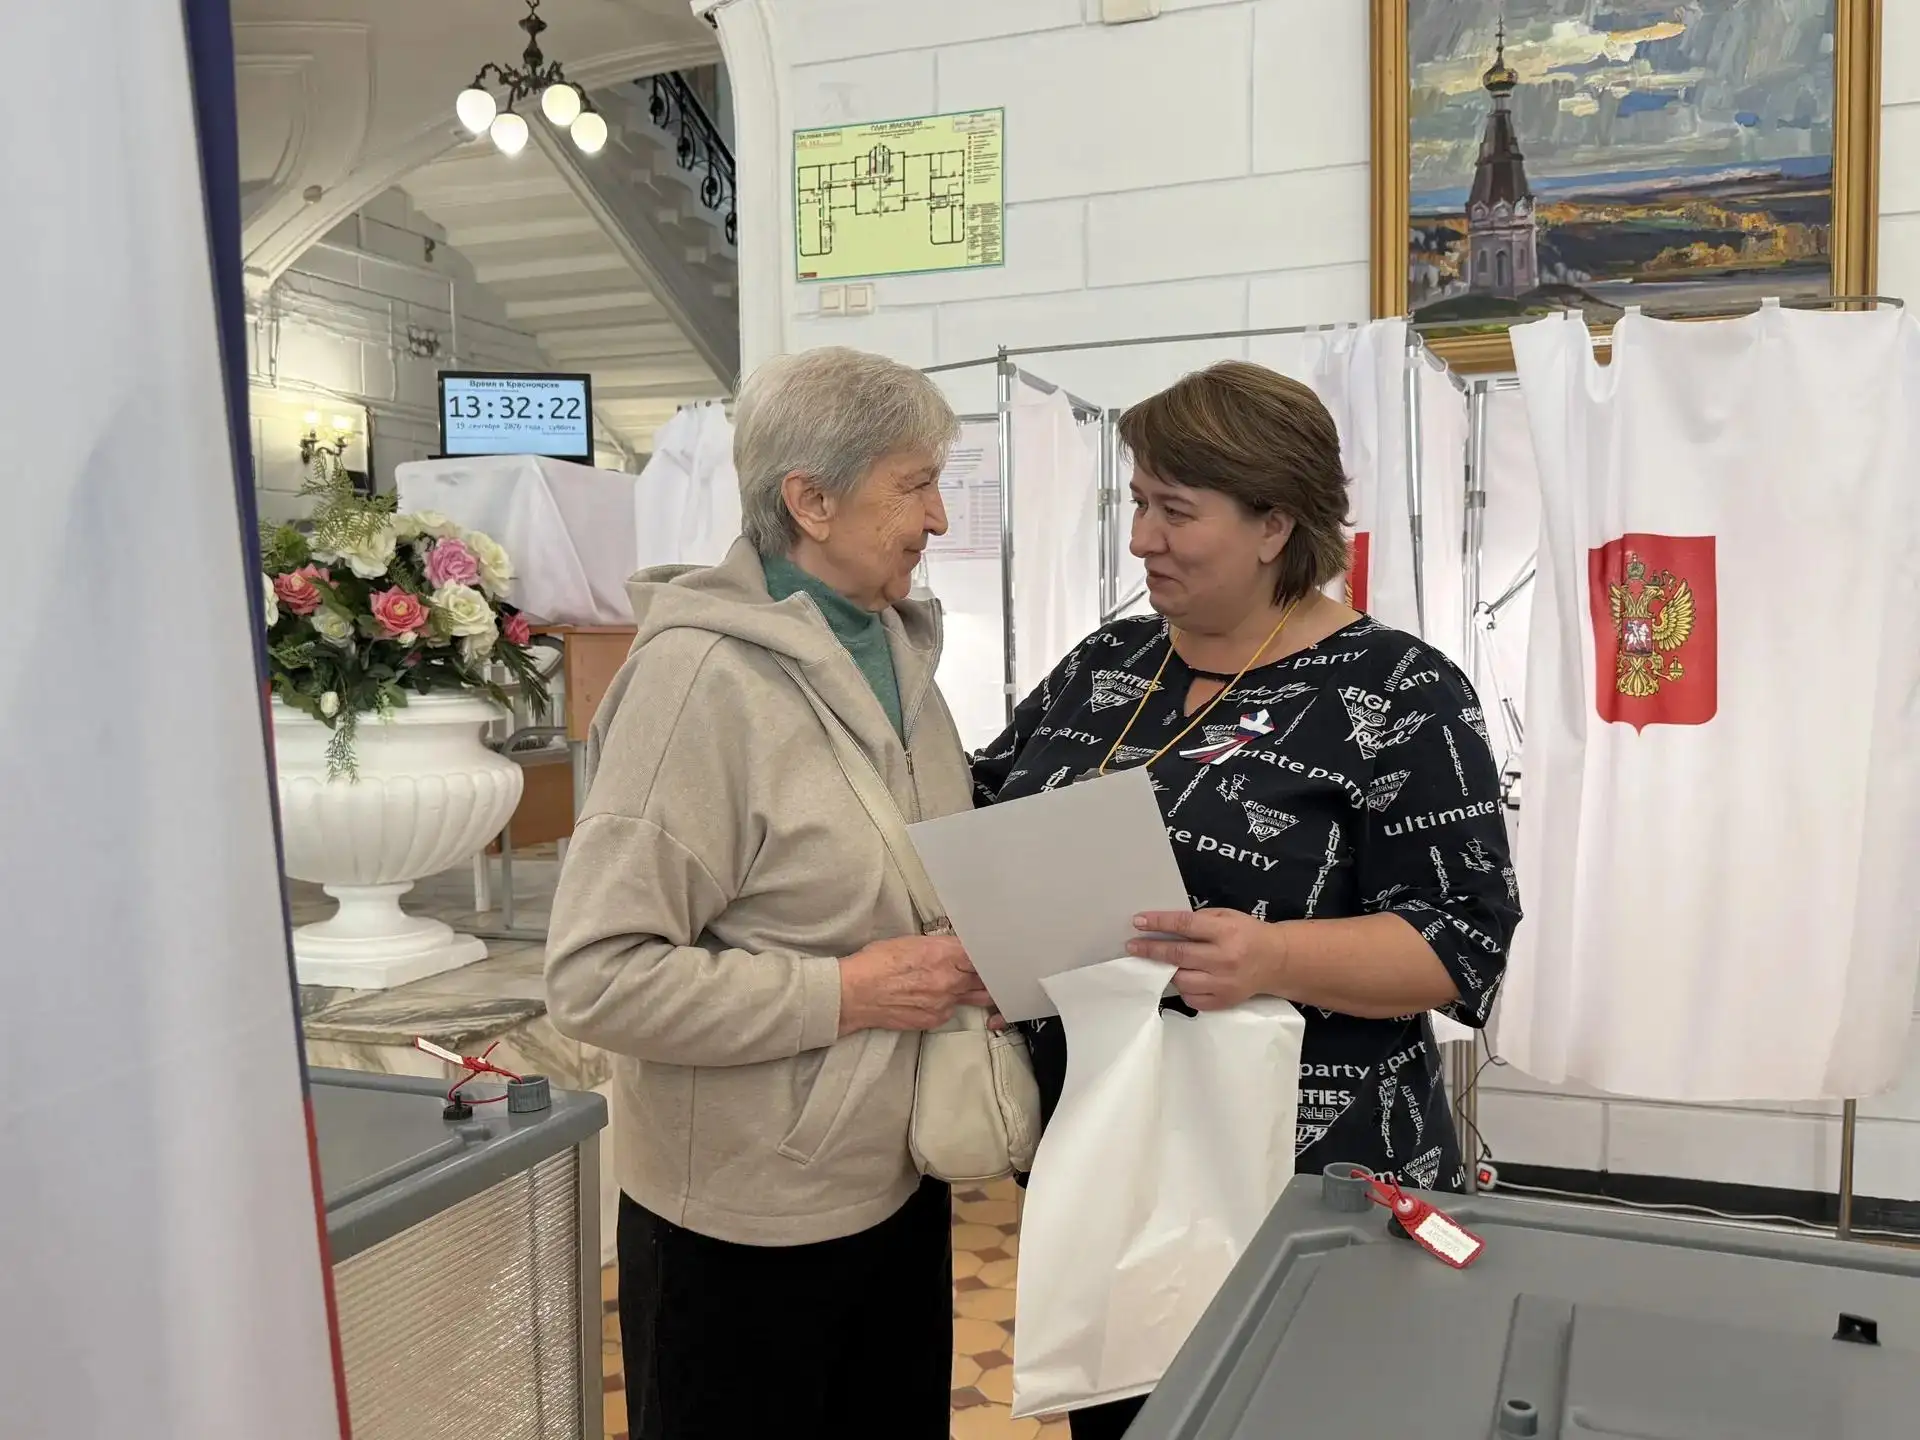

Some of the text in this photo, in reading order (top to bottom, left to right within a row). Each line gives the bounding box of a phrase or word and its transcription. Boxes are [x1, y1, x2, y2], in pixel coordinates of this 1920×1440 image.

[469, 380, 497, 389] Время
[506, 381, 560, 389] Красноярске
[449, 396, 582, 419] 13:32:22
[1293, 649, 1368, 670] party
[1384, 659, 1410, 692] ultimate
[1049, 727, 1103, 746] party
[1245, 800, 1297, 824] EIGHTIES
[1383, 799, 1495, 837] ultimate
[1196, 834, 1280, 872] party
[1298, 1063, 1371, 1079] party
[1405, 1146, 1442, 1170] EIGHTIES
